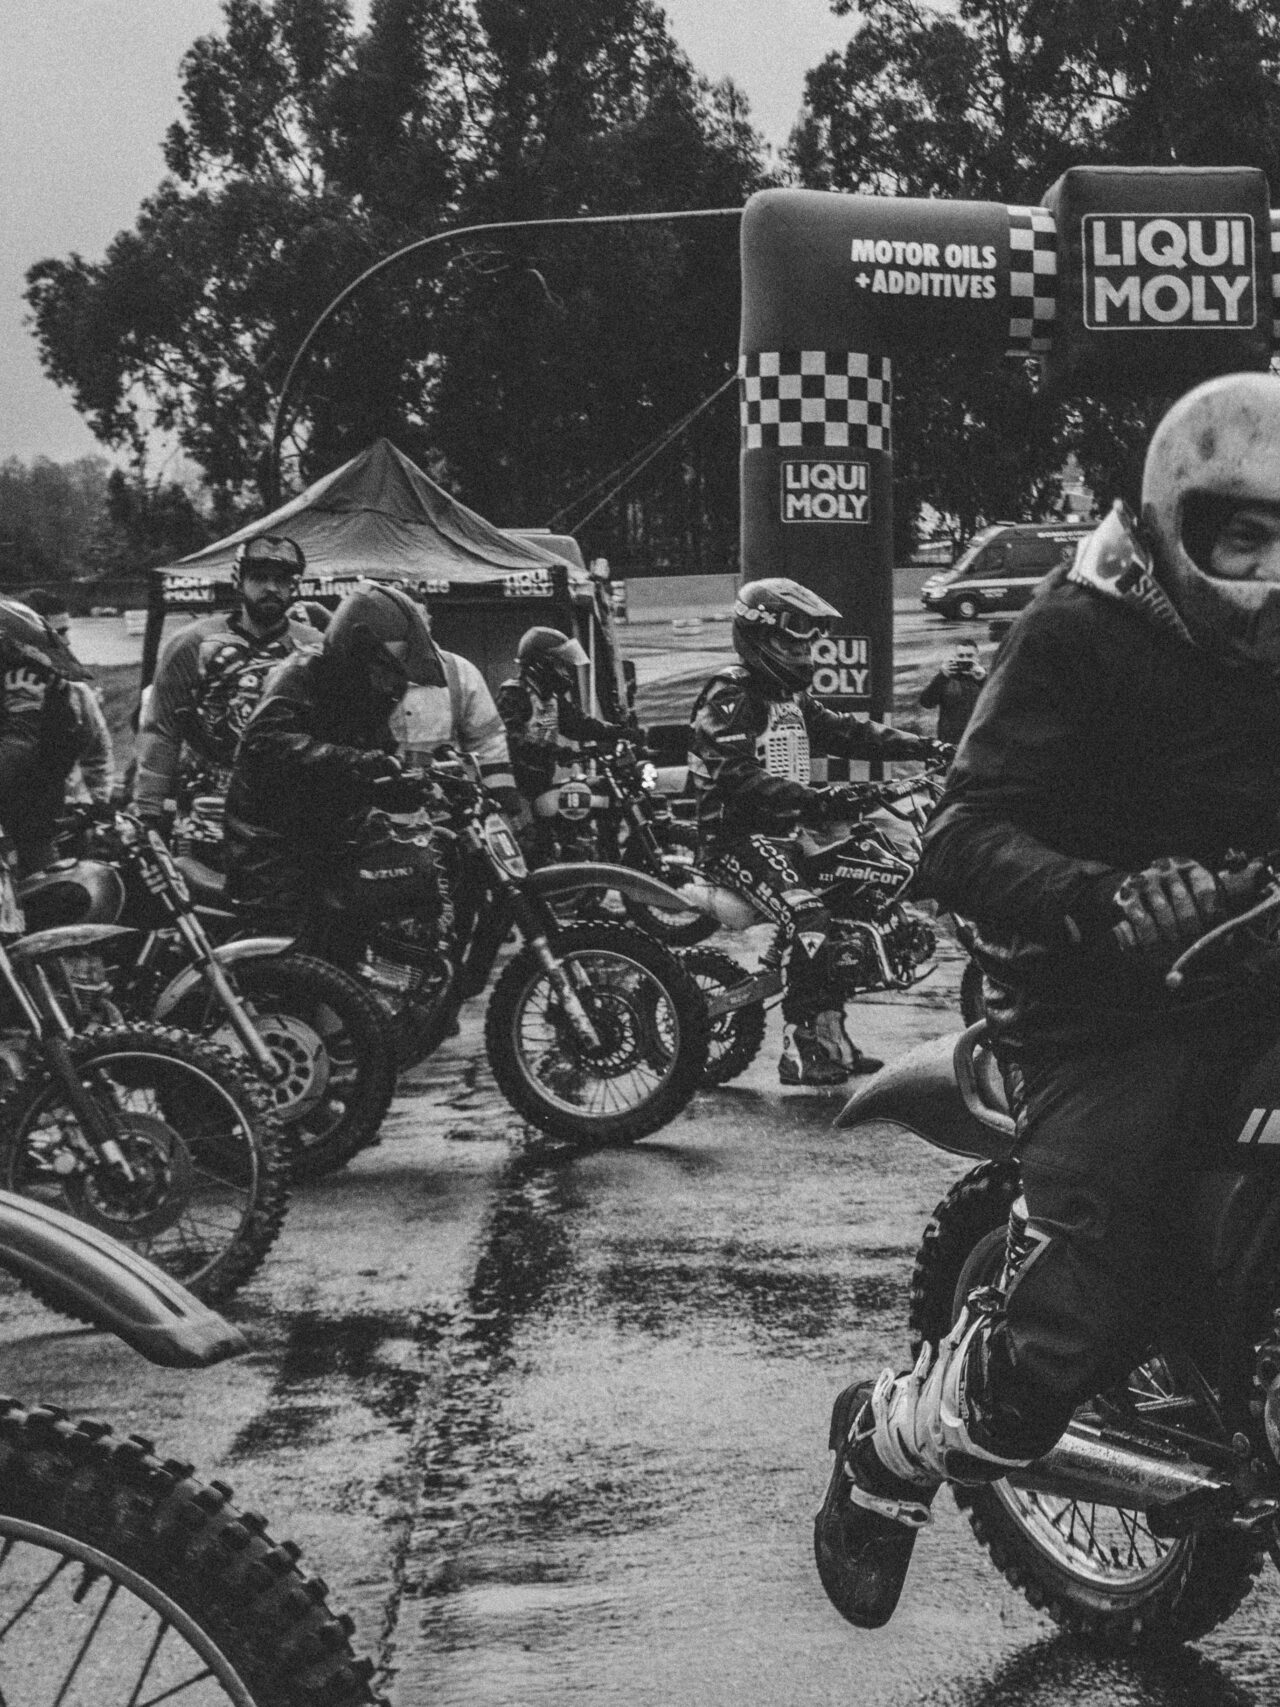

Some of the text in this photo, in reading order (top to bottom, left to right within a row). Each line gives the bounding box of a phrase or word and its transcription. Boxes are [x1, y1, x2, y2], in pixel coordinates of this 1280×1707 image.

[850, 238, 997, 270] MOTOR OILS
[1092, 218, 1246, 270] LIQUI
[854, 268, 997, 299] +ADDITIVES
[1093, 274, 1251, 323] MOLY
[785, 463, 867, 491] LIQUI
[785, 492, 869, 520] MOLY
[811, 638, 867, 665] QUI
[812, 667, 869, 693] OLY
